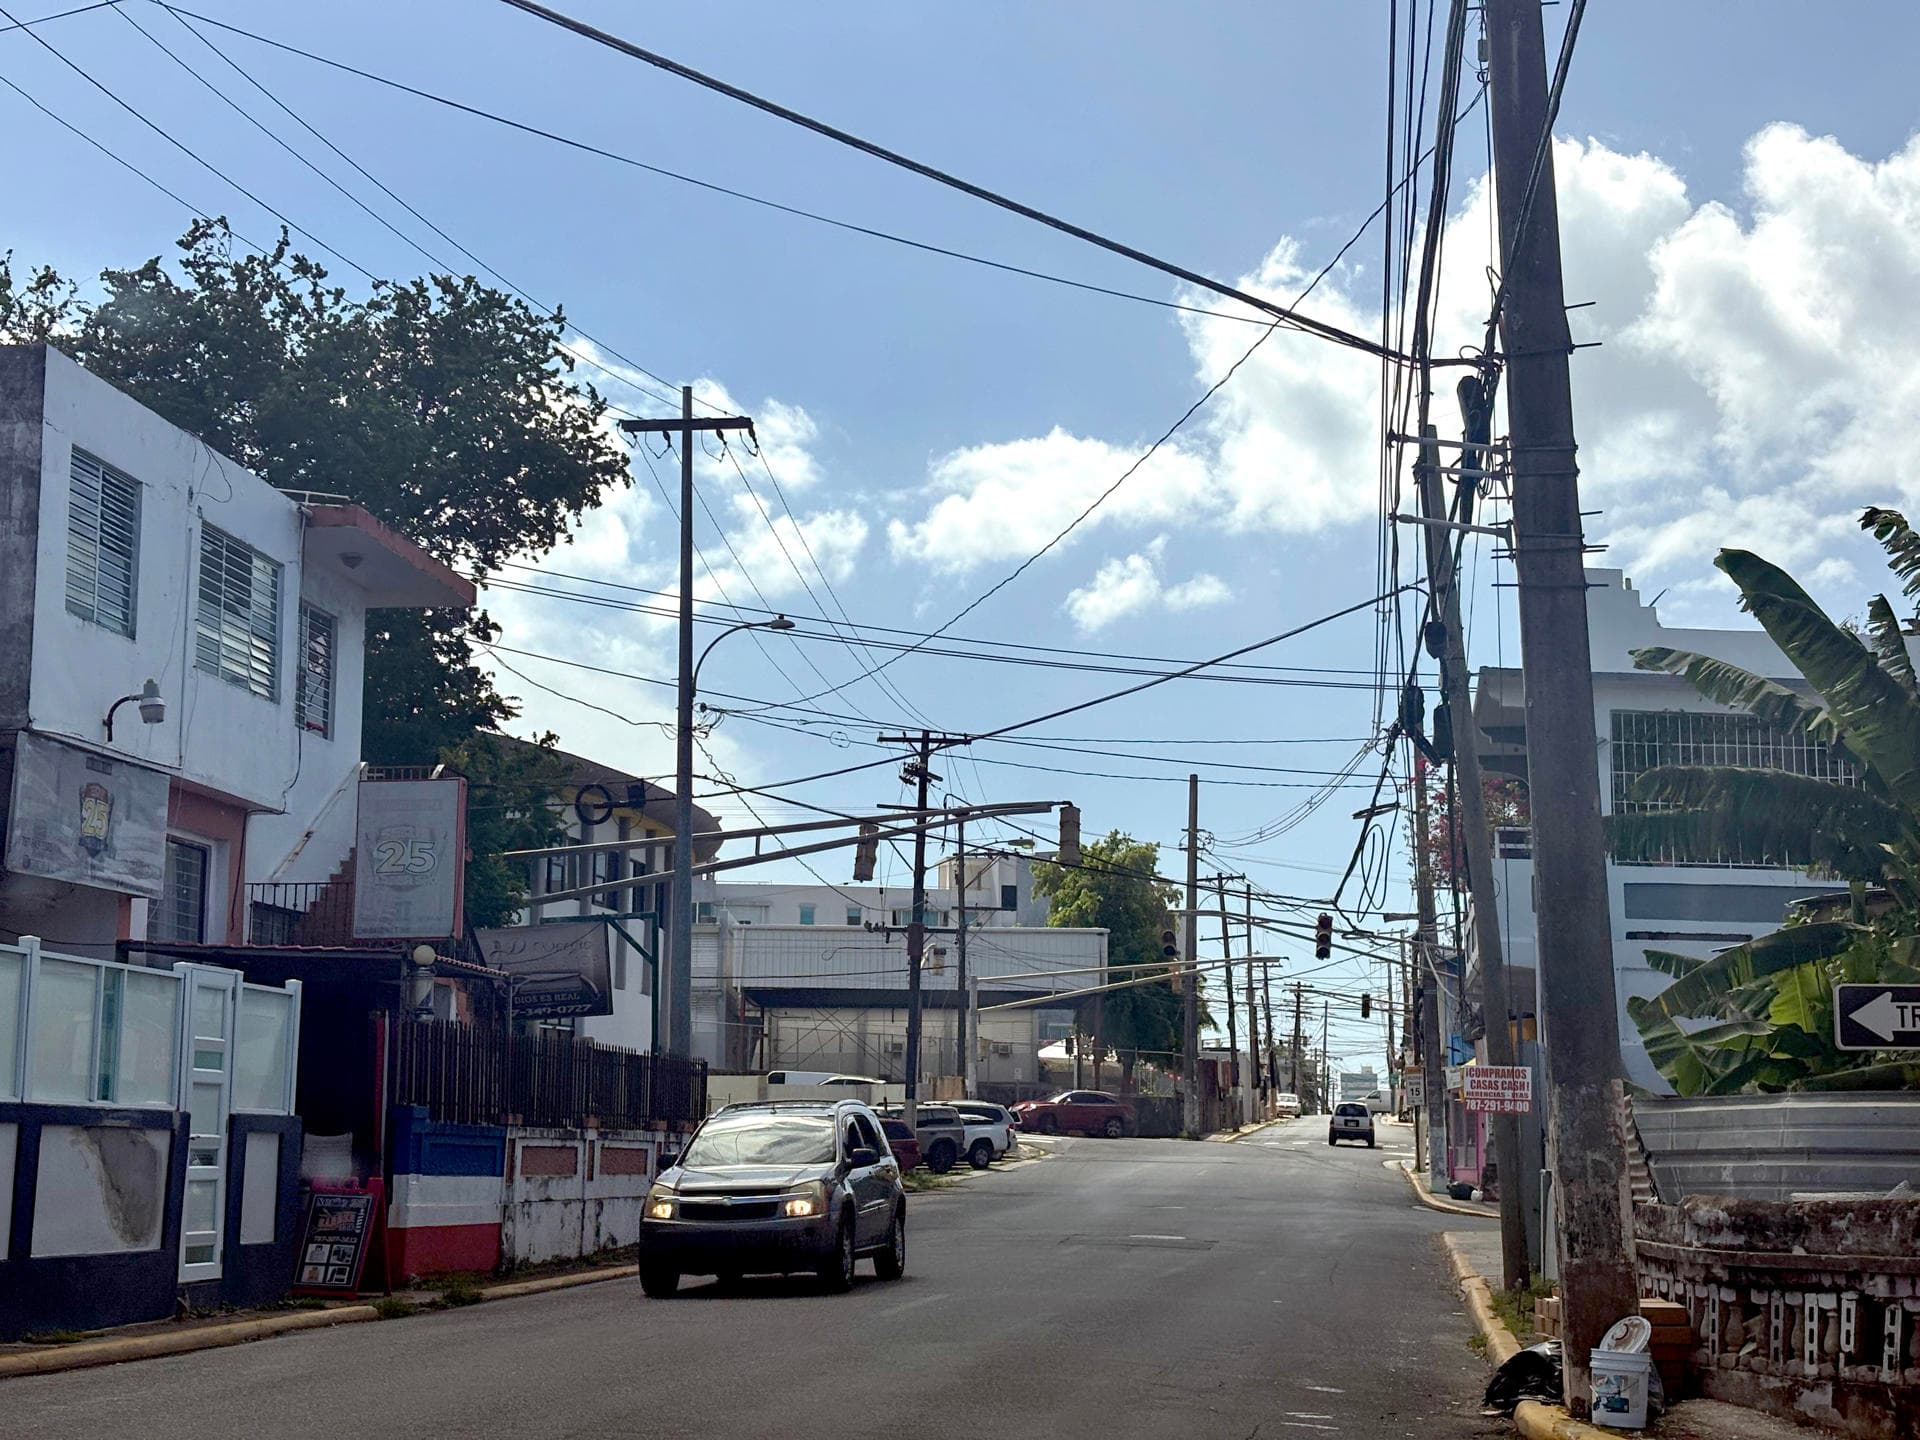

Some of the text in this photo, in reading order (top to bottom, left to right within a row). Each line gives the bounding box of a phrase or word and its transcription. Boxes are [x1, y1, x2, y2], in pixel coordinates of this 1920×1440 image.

[82, 799, 109, 839] 25
[375, 840, 436, 874] 25
[514, 993, 580, 1004] DIOS ES REAL
[1465, 1067, 1527, 1079] ¡COMPRAMOS
[1470, 1079, 1529, 1091] CASAS CASH!
[1410, 1088, 1421, 1096] 15
